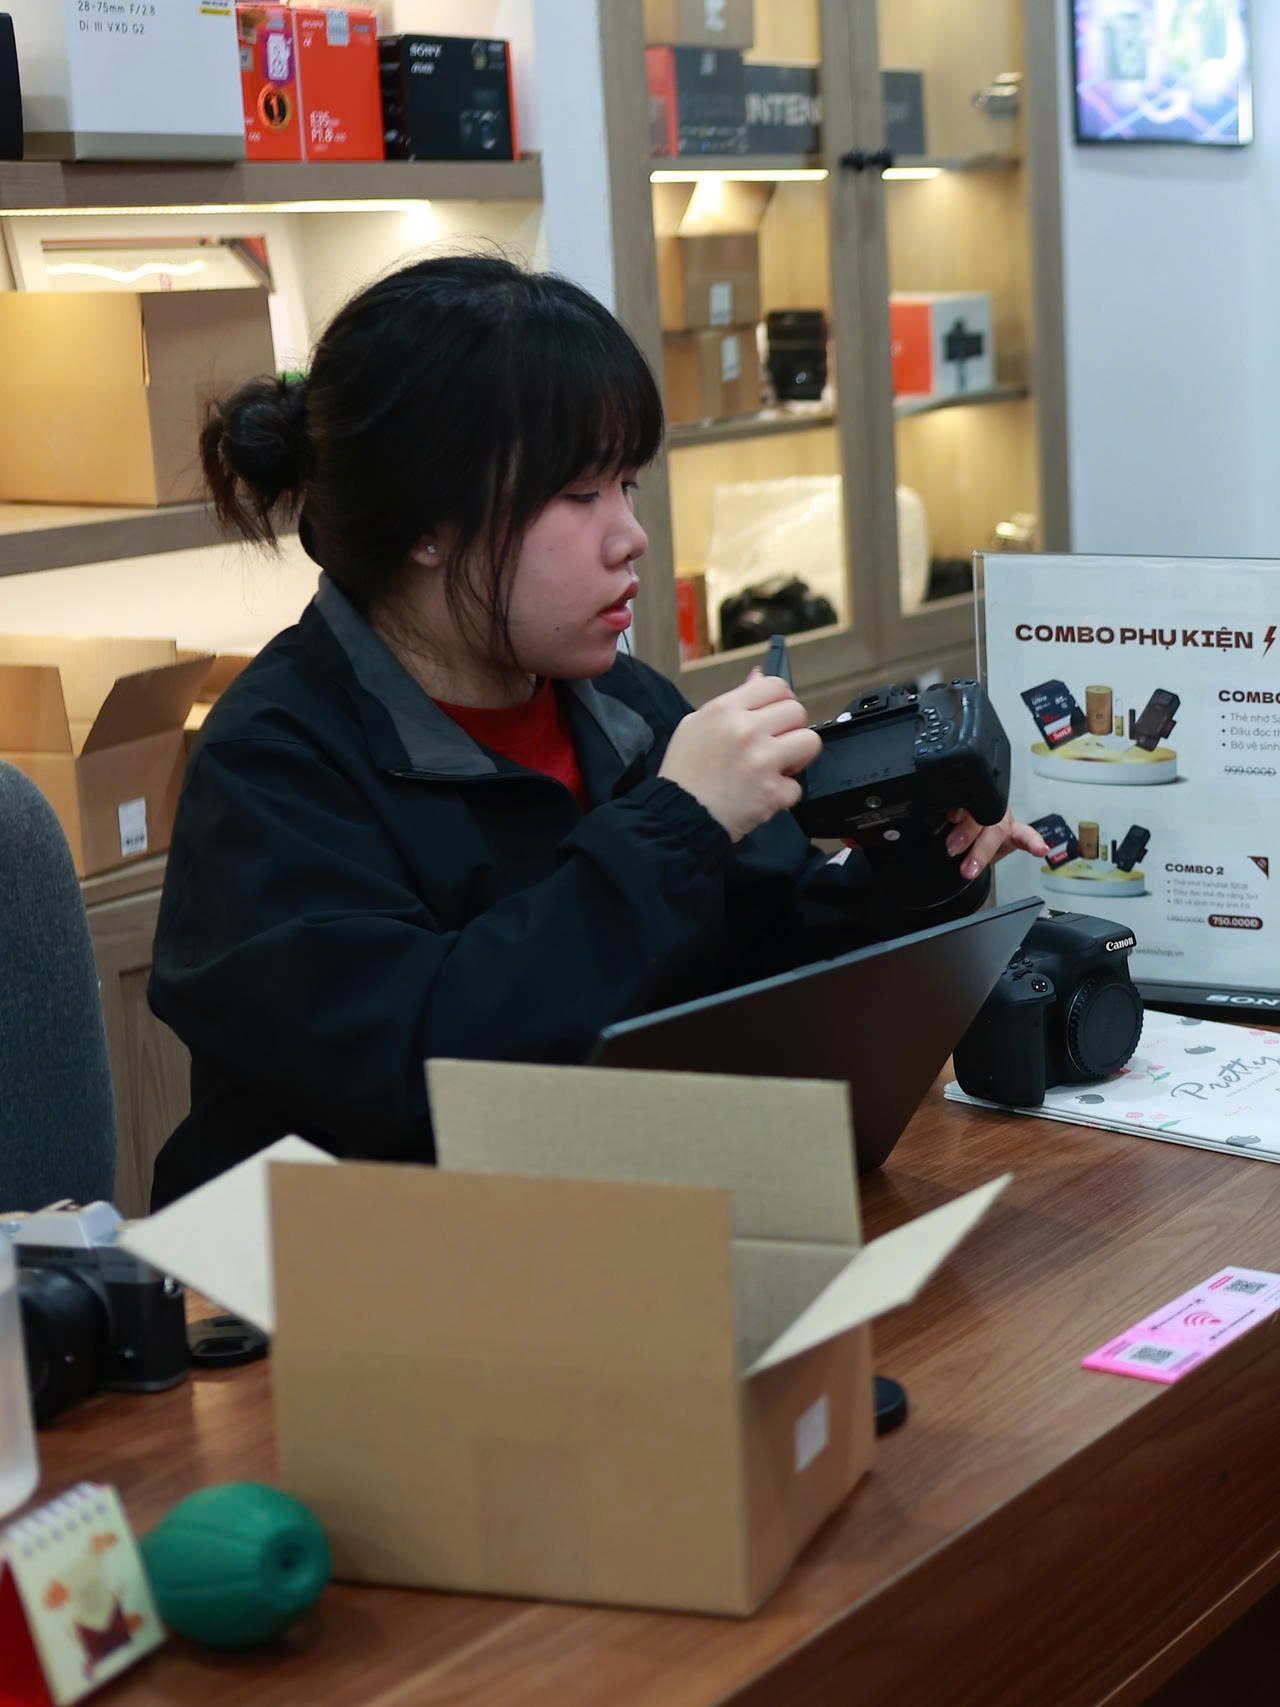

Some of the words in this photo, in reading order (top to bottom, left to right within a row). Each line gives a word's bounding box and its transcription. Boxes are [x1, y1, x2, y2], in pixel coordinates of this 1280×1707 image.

[409, 42, 442, 57] SONY
[1014, 624, 1115, 645] COMBO
[1120, 627, 1177, 650] PHỤ
[1182, 626, 1253, 652] KIỆN
[1260, 742, 1280, 752] sinh
[1165, 863, 1213, 875] COMBO
[1216, 866, 1224, 875] 2
[1106, 936, 1134, 952] Canon
